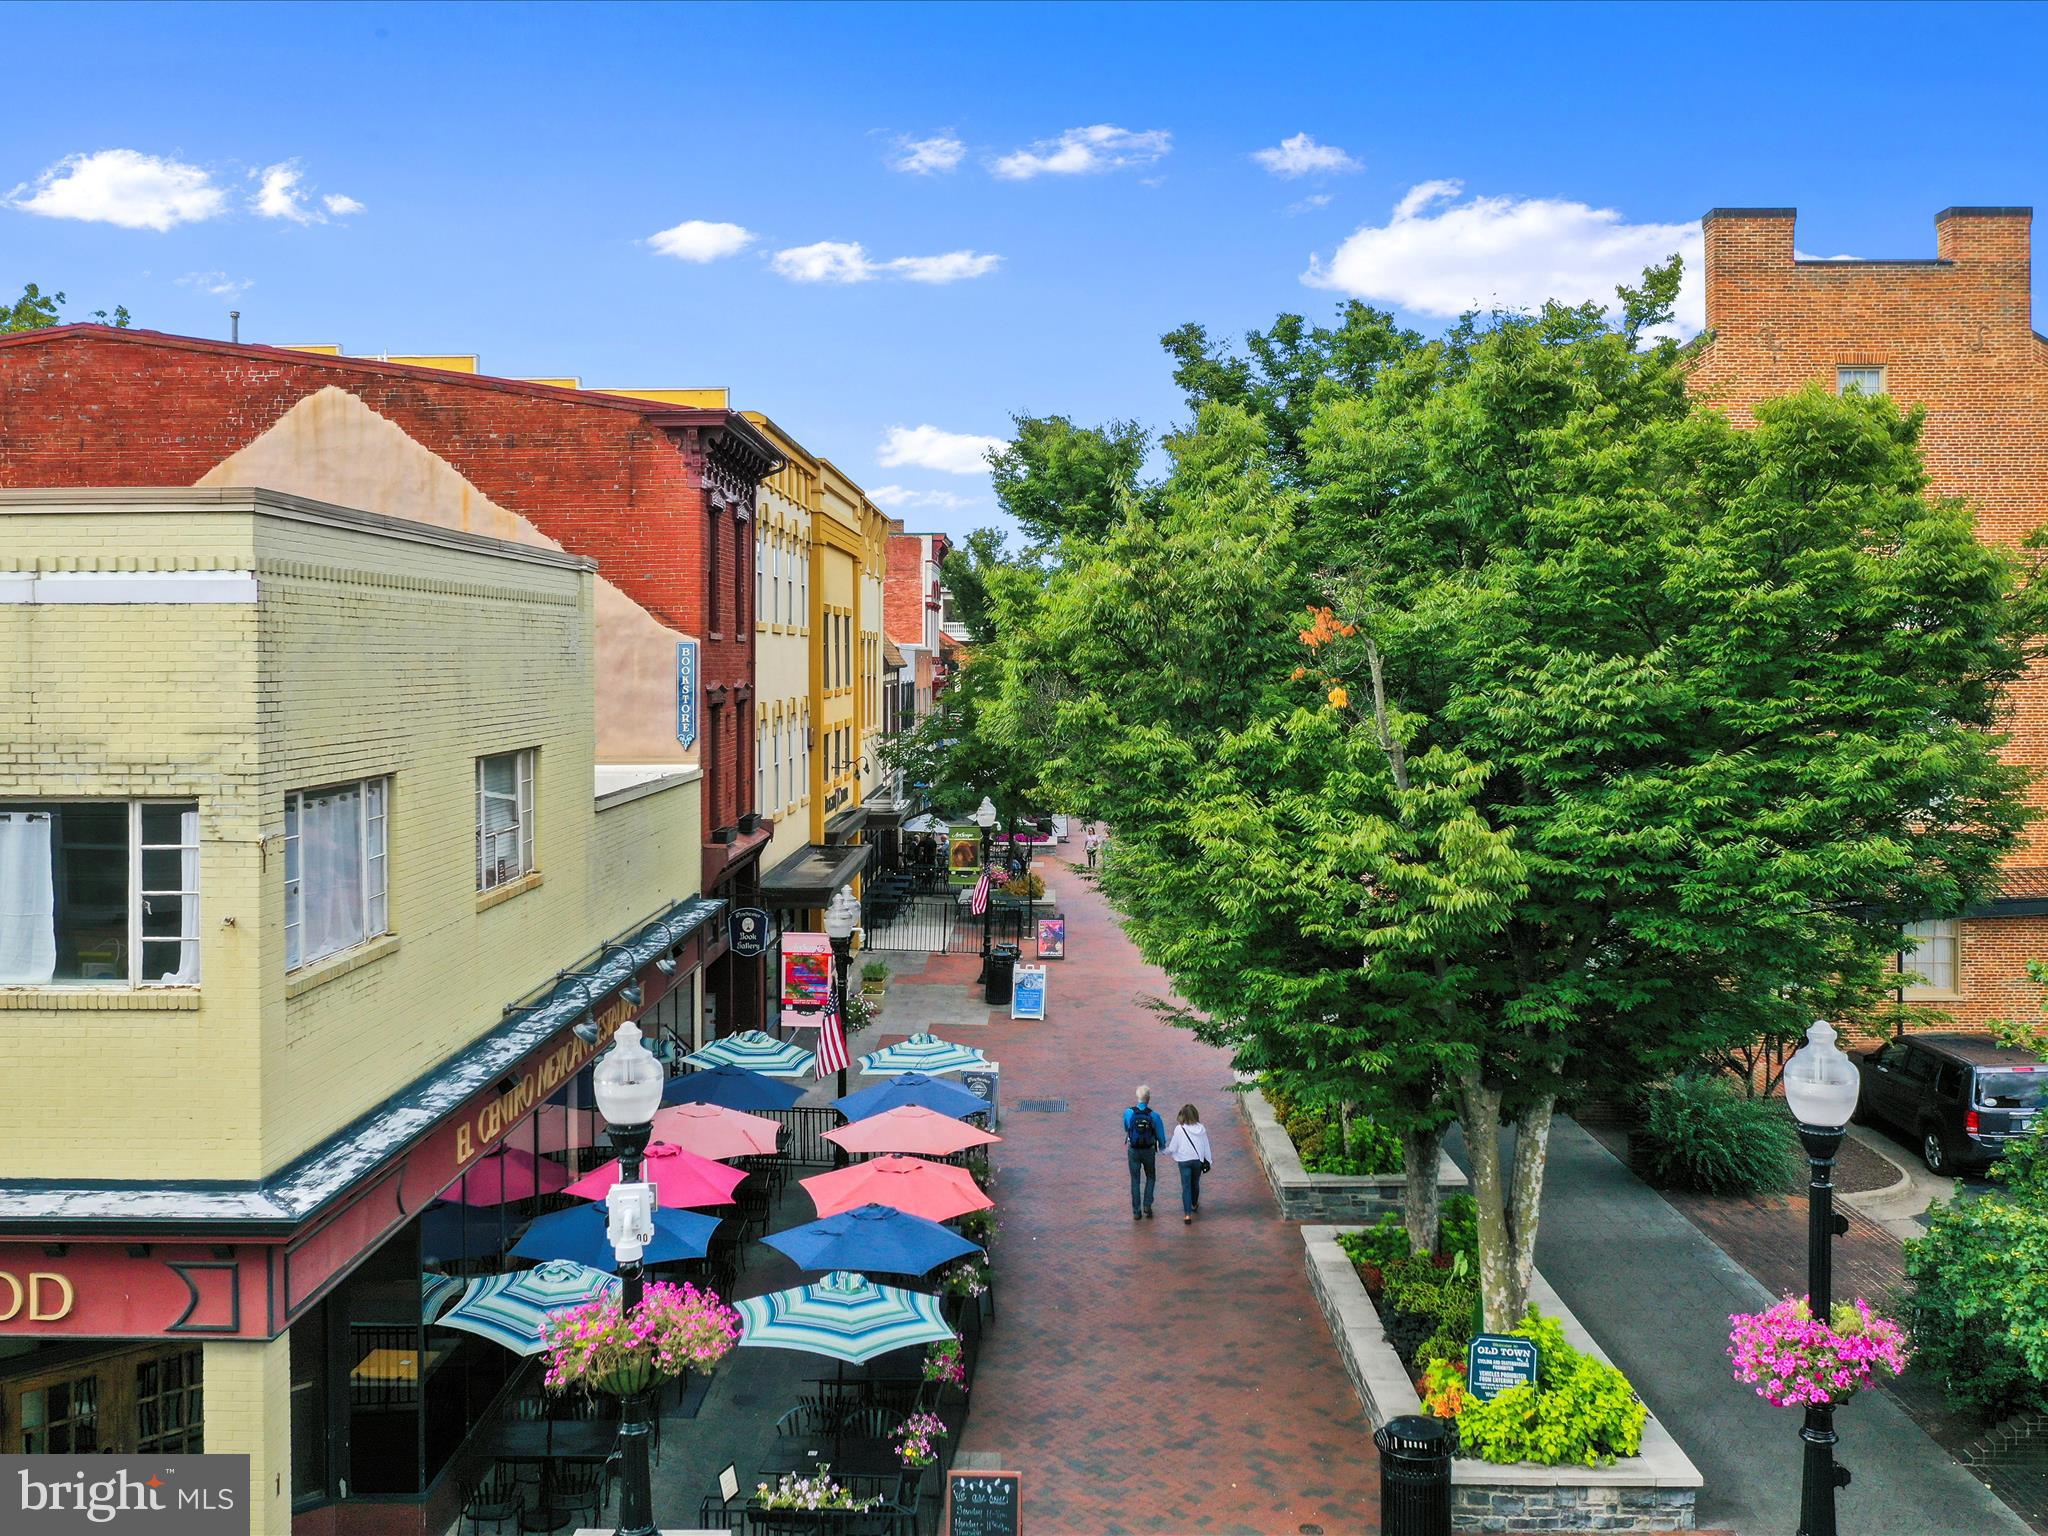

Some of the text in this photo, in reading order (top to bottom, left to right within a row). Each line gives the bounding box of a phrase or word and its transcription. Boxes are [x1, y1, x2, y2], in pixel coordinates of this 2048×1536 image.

[681, 647, 690, 732] BOOKSTORE
[738, 932, 757, 940] Book
[736, 941, 760, 950] Gallery
[456, 1121, 475, 1165] EL
[477, 1073, 535, 1144] CENTRO
[537, 1034, 594, 1098] MEXICAN
[1477, 1346, 1531, 1358] OLD TOWN
[953, 1489, 967, 1502] We
